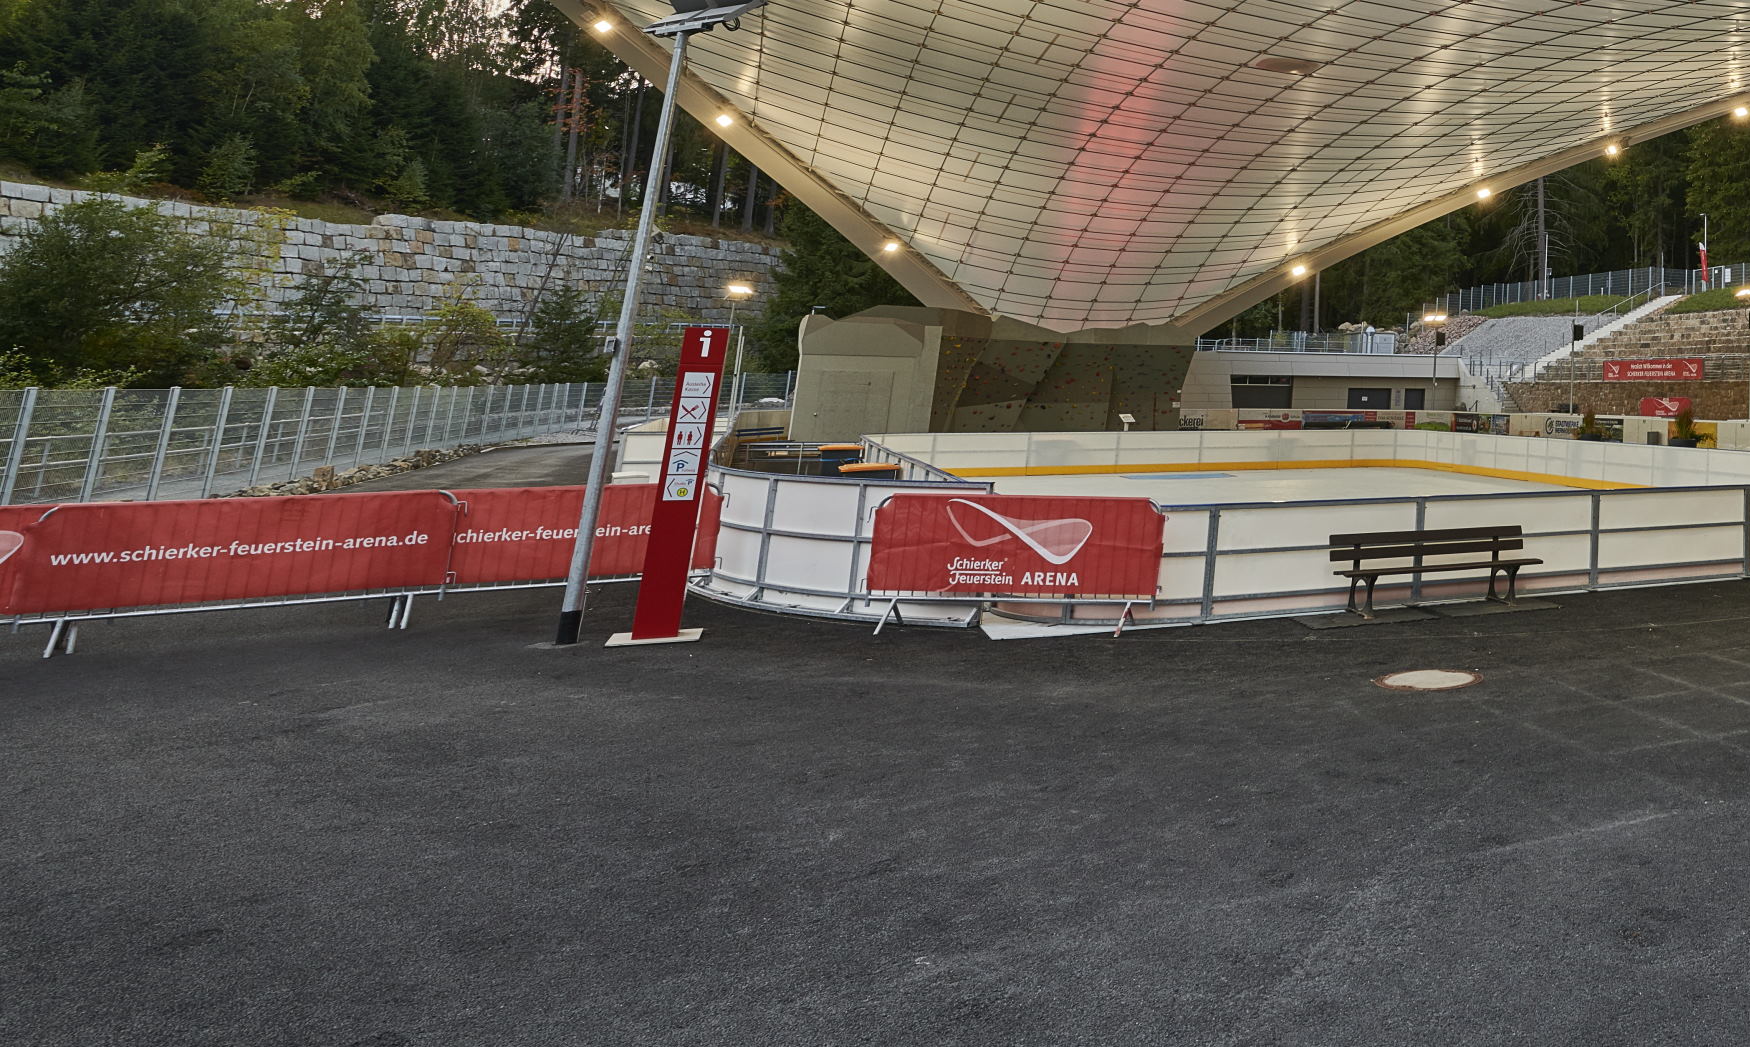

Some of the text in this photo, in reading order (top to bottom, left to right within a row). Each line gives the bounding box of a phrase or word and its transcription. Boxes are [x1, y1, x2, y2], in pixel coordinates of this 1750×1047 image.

[1178, 414, 1204, 428] ckerei
[453, 523, 652, 545] chierker-feuerein-are
[50, 530, 429, 567] www.schierker-feuerstein-arena.de
[946, 556, 1005, 571] Schierker
[1020, 571, 1080, 586] ARENA
